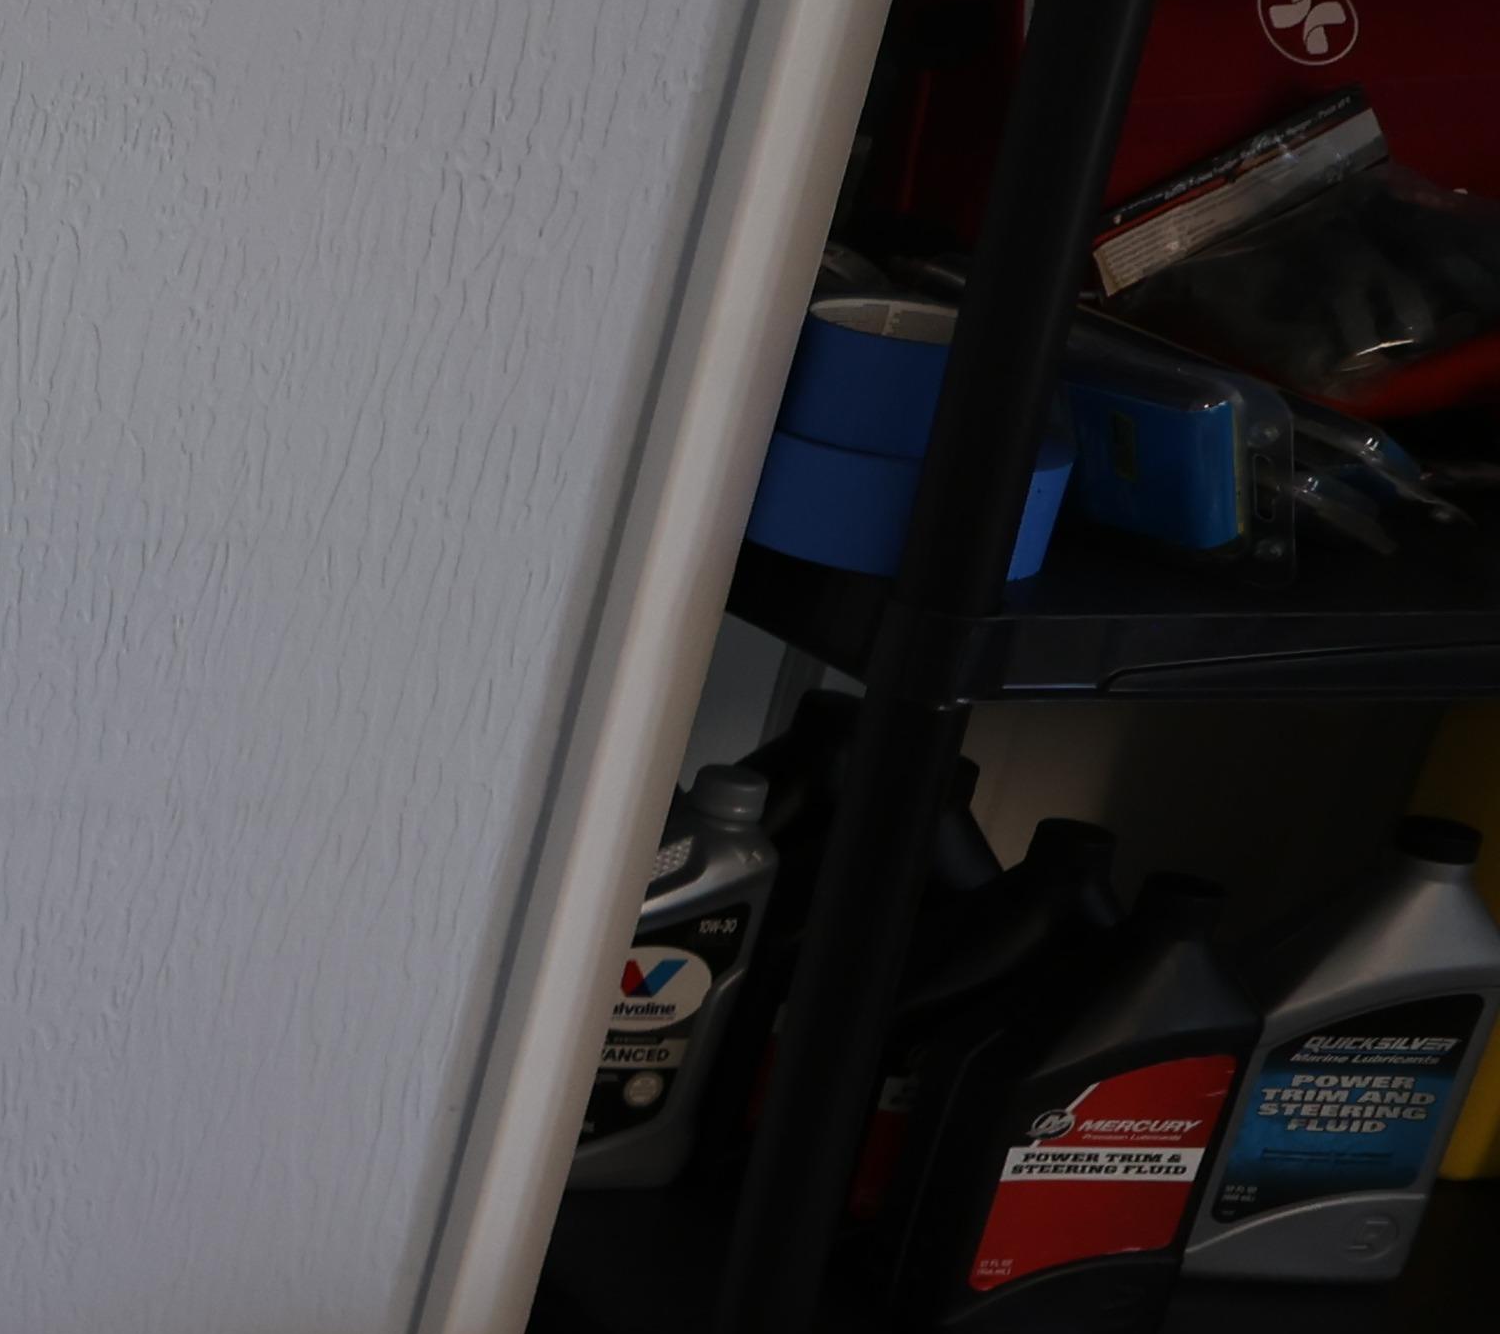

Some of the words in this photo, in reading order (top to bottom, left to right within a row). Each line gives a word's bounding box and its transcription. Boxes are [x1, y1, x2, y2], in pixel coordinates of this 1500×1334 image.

[612, 1001, 677, 1016] lvoline
[1302, 1035, 1463, 1053] QUICKSILVER
[601, 1047, 671, 1063] ANCED
[1289, 1053, 1349, 1064] Marine
[1351, 1054, 1442, 1066] Lubricants
[1290, 1074, 1416, 1090] POWER
[1260, 1088, 1350, 1104] TRIM
[1355, 1090, 1437, 1106] AND
[1257, 1102, 1428, 1120] STEERING
[1076, 1118, 1204, 1133] MERCURY
[1286, 1118, 1388, 1133] FLUID
[1022, 1153, 1100, 1163] POWER
[1105, 1153, 1162, 1164] TRIM
[1166, 1153, 1183, 1164] &
[1010, 1164, 1118, 1175] STEERING
[1121, 1164, 1187, 1175] FLUID
